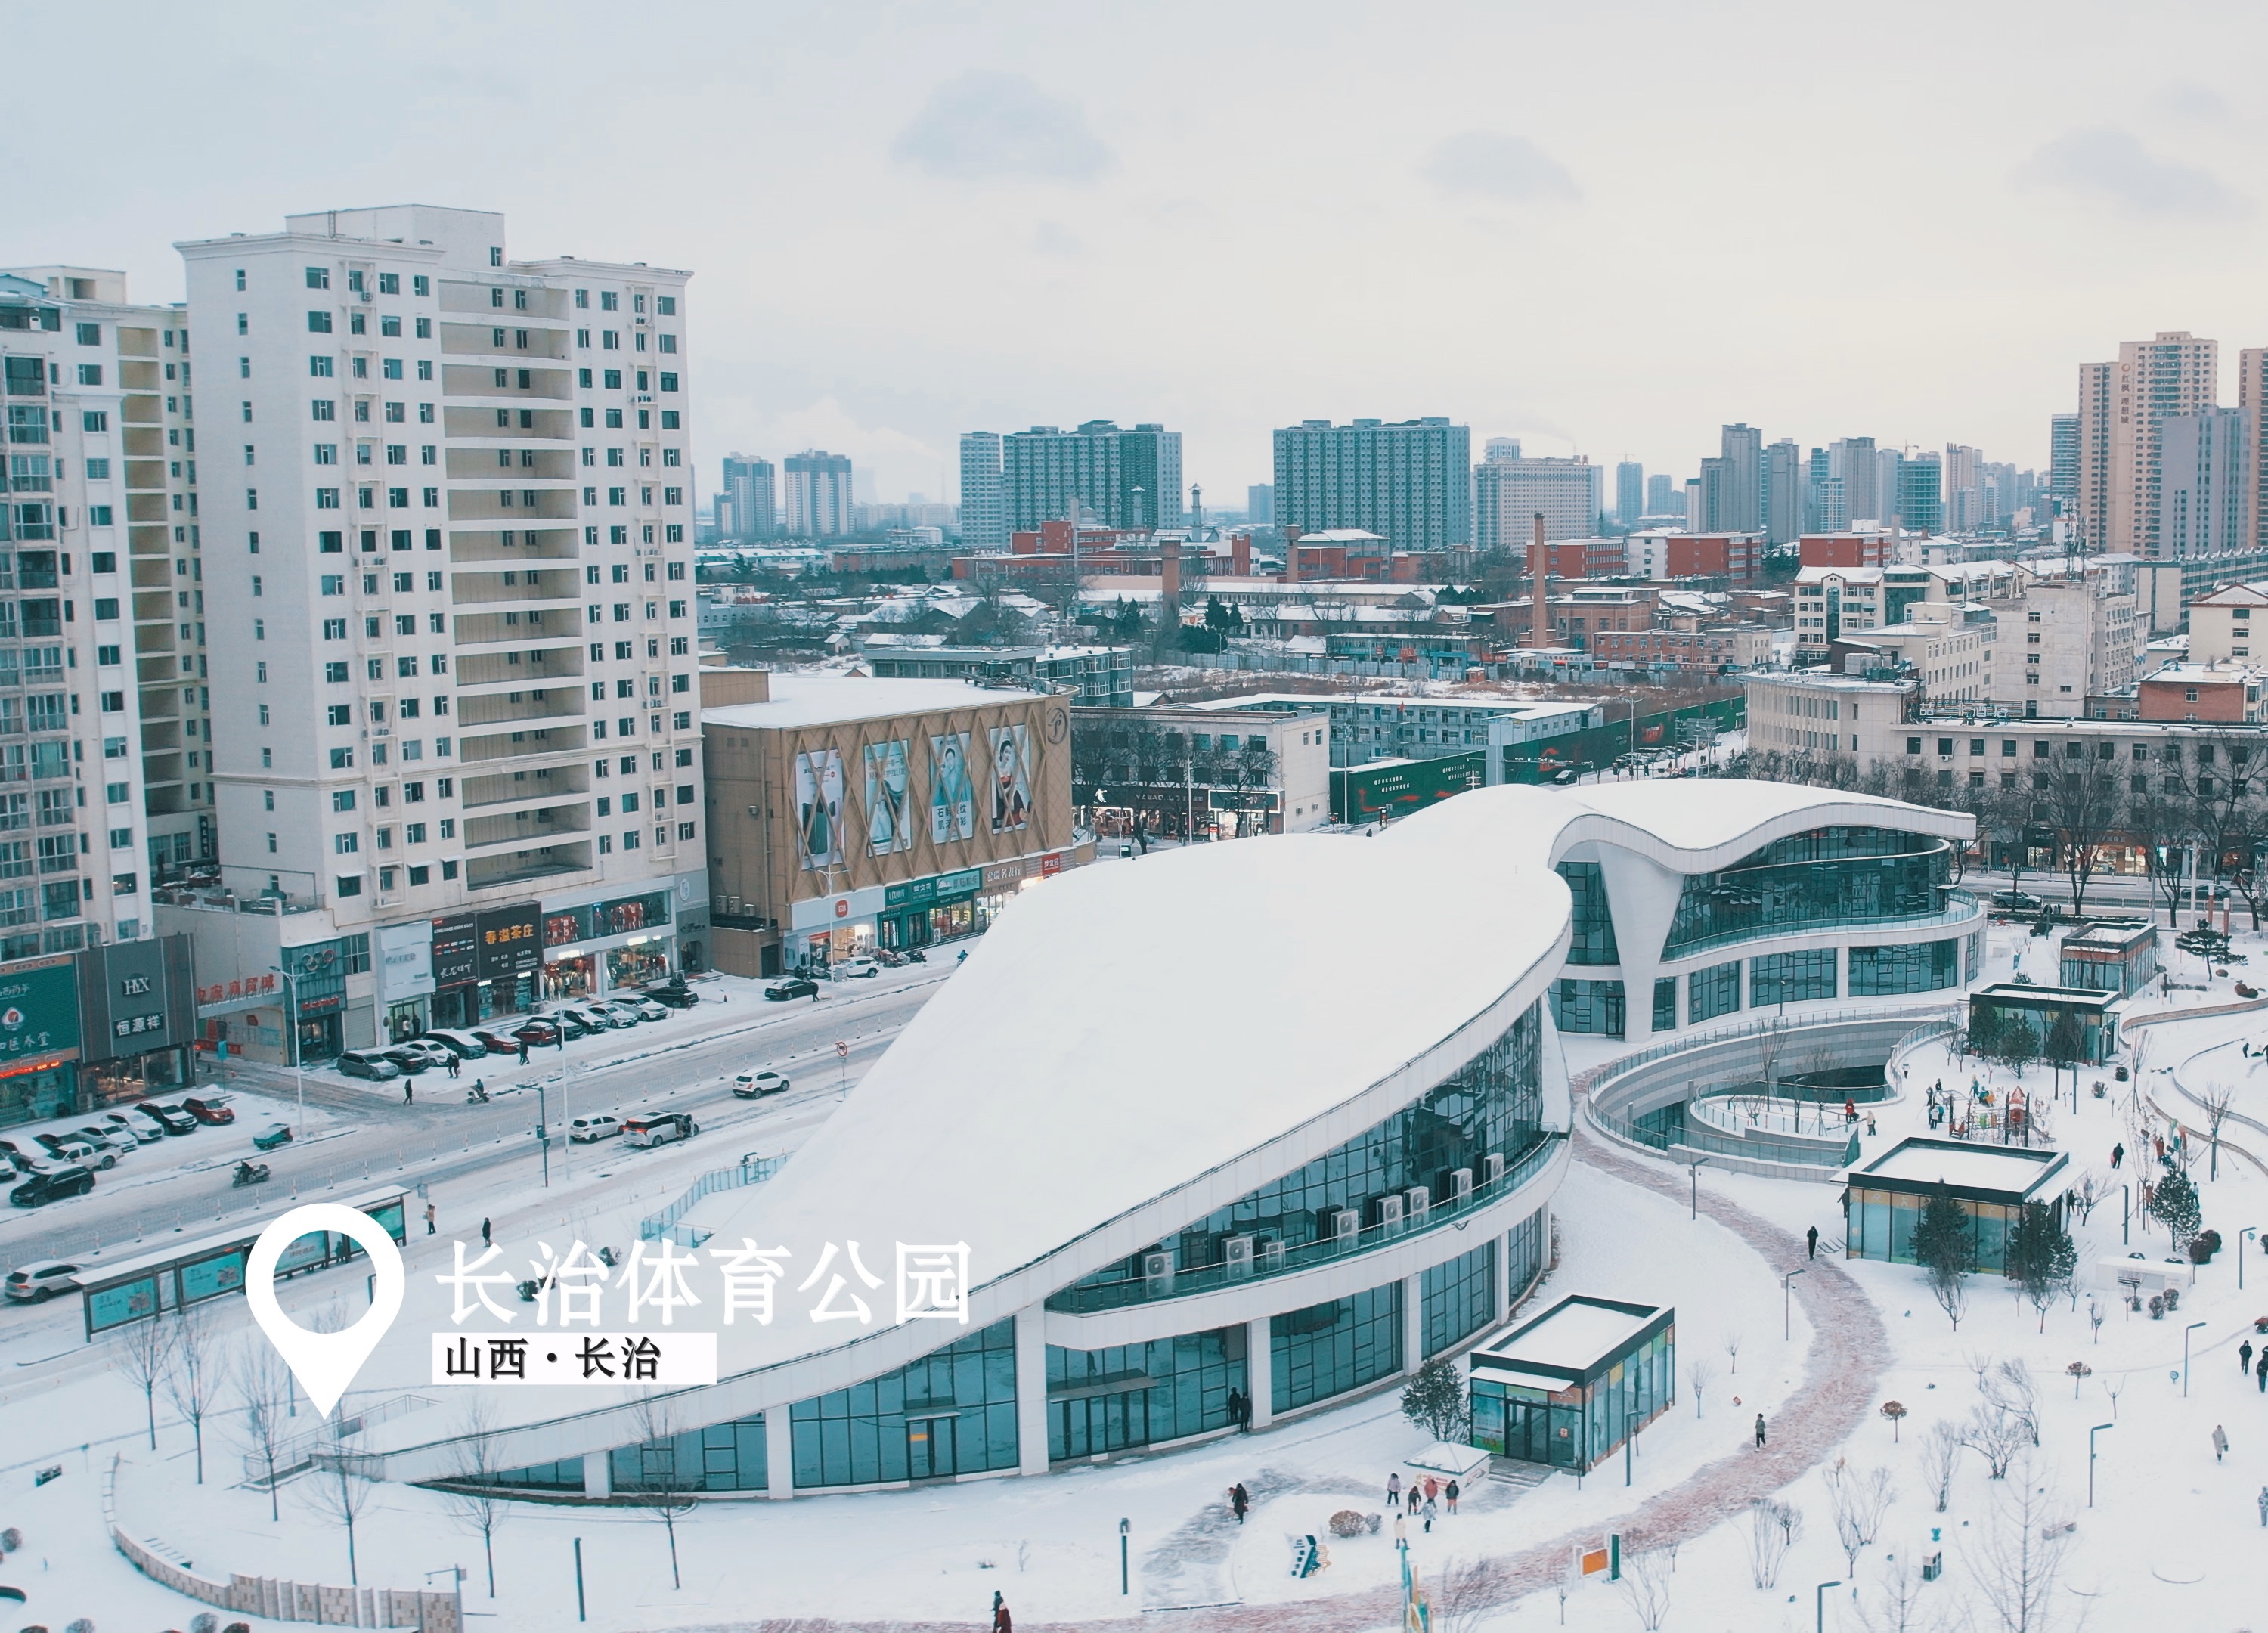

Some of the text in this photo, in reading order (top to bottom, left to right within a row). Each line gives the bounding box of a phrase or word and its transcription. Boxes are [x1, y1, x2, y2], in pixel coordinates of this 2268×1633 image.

[485, 923, 534, 944] 春溢茶庄
[116, 1015, 160, 1037] 恒源祥
